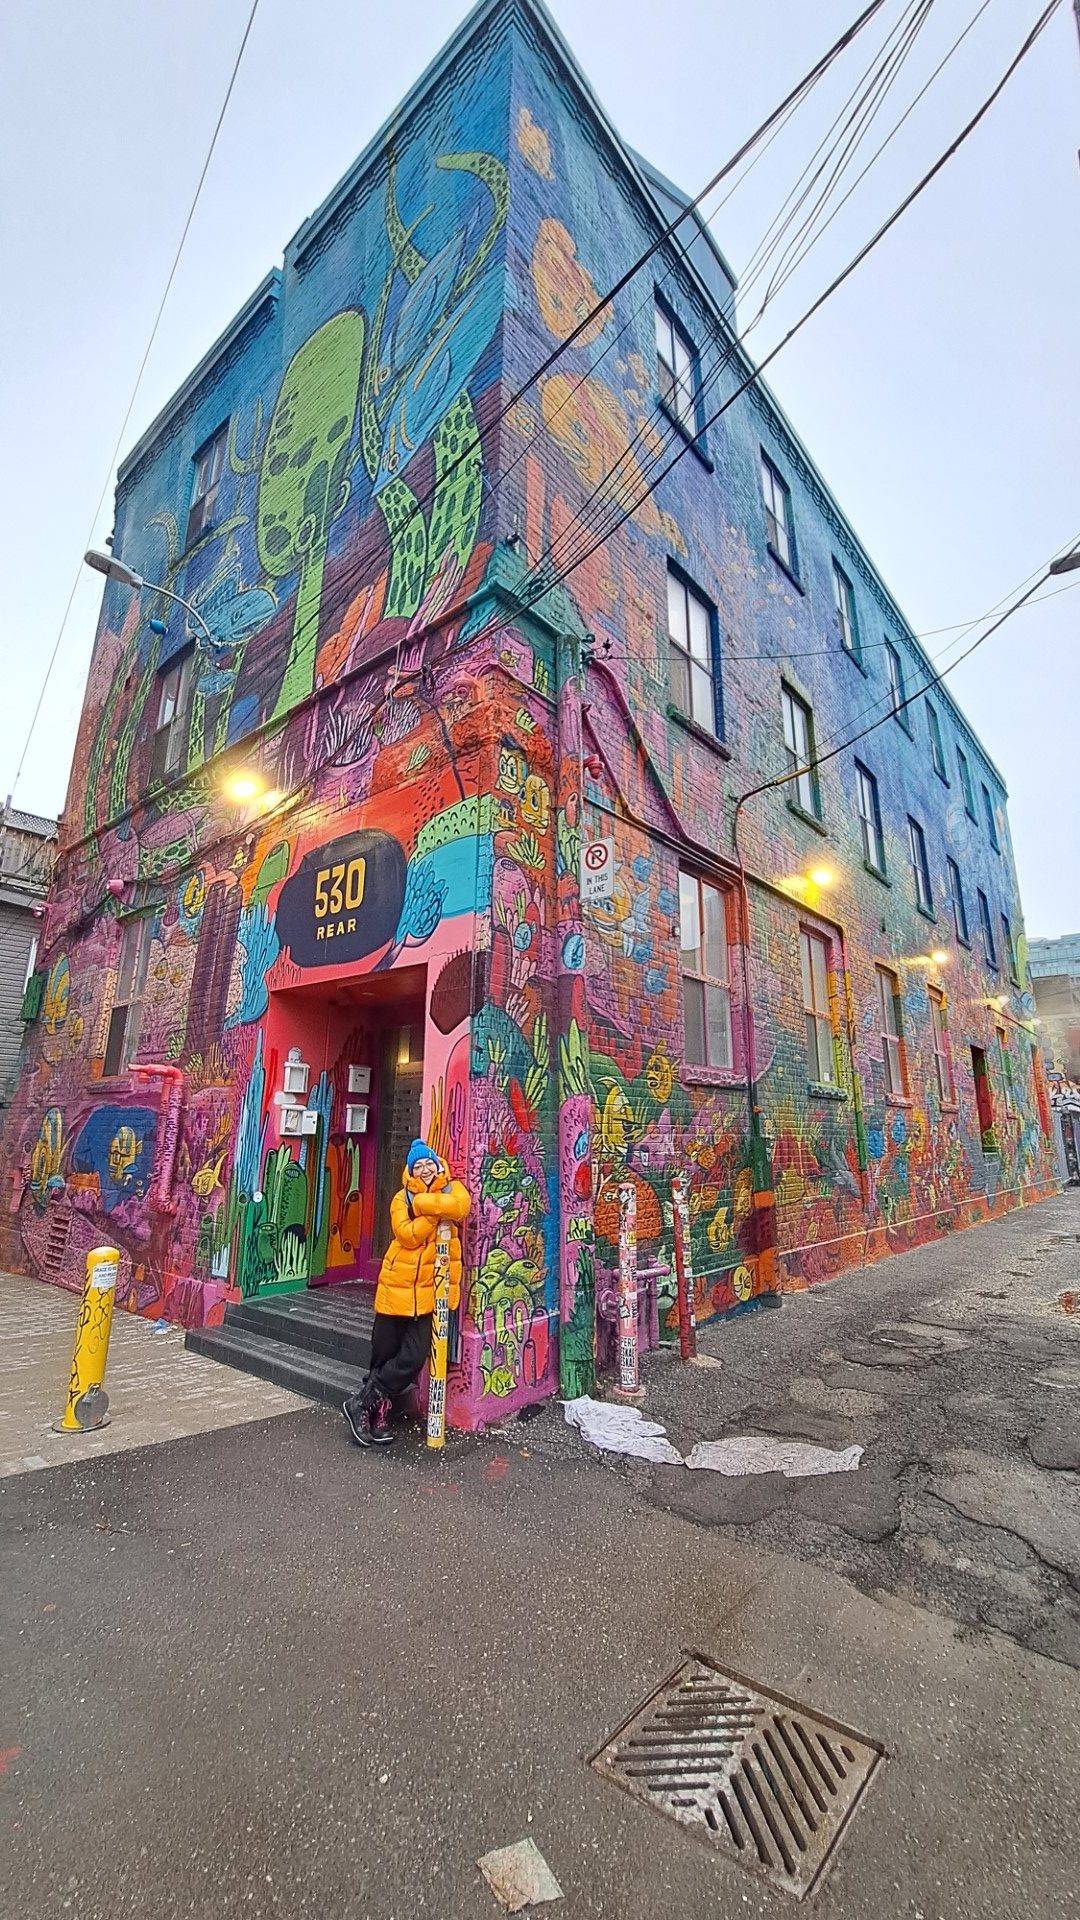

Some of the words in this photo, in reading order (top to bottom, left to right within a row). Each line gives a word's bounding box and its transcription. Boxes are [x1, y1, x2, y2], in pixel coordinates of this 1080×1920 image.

[314, 857, 367, 918] 530
[586, 877, 593, 885] IN
[594, 873, 608, 882] THIS
[589, 884, 605, 895] LANE
[316, 917, 357, 940] REAR
